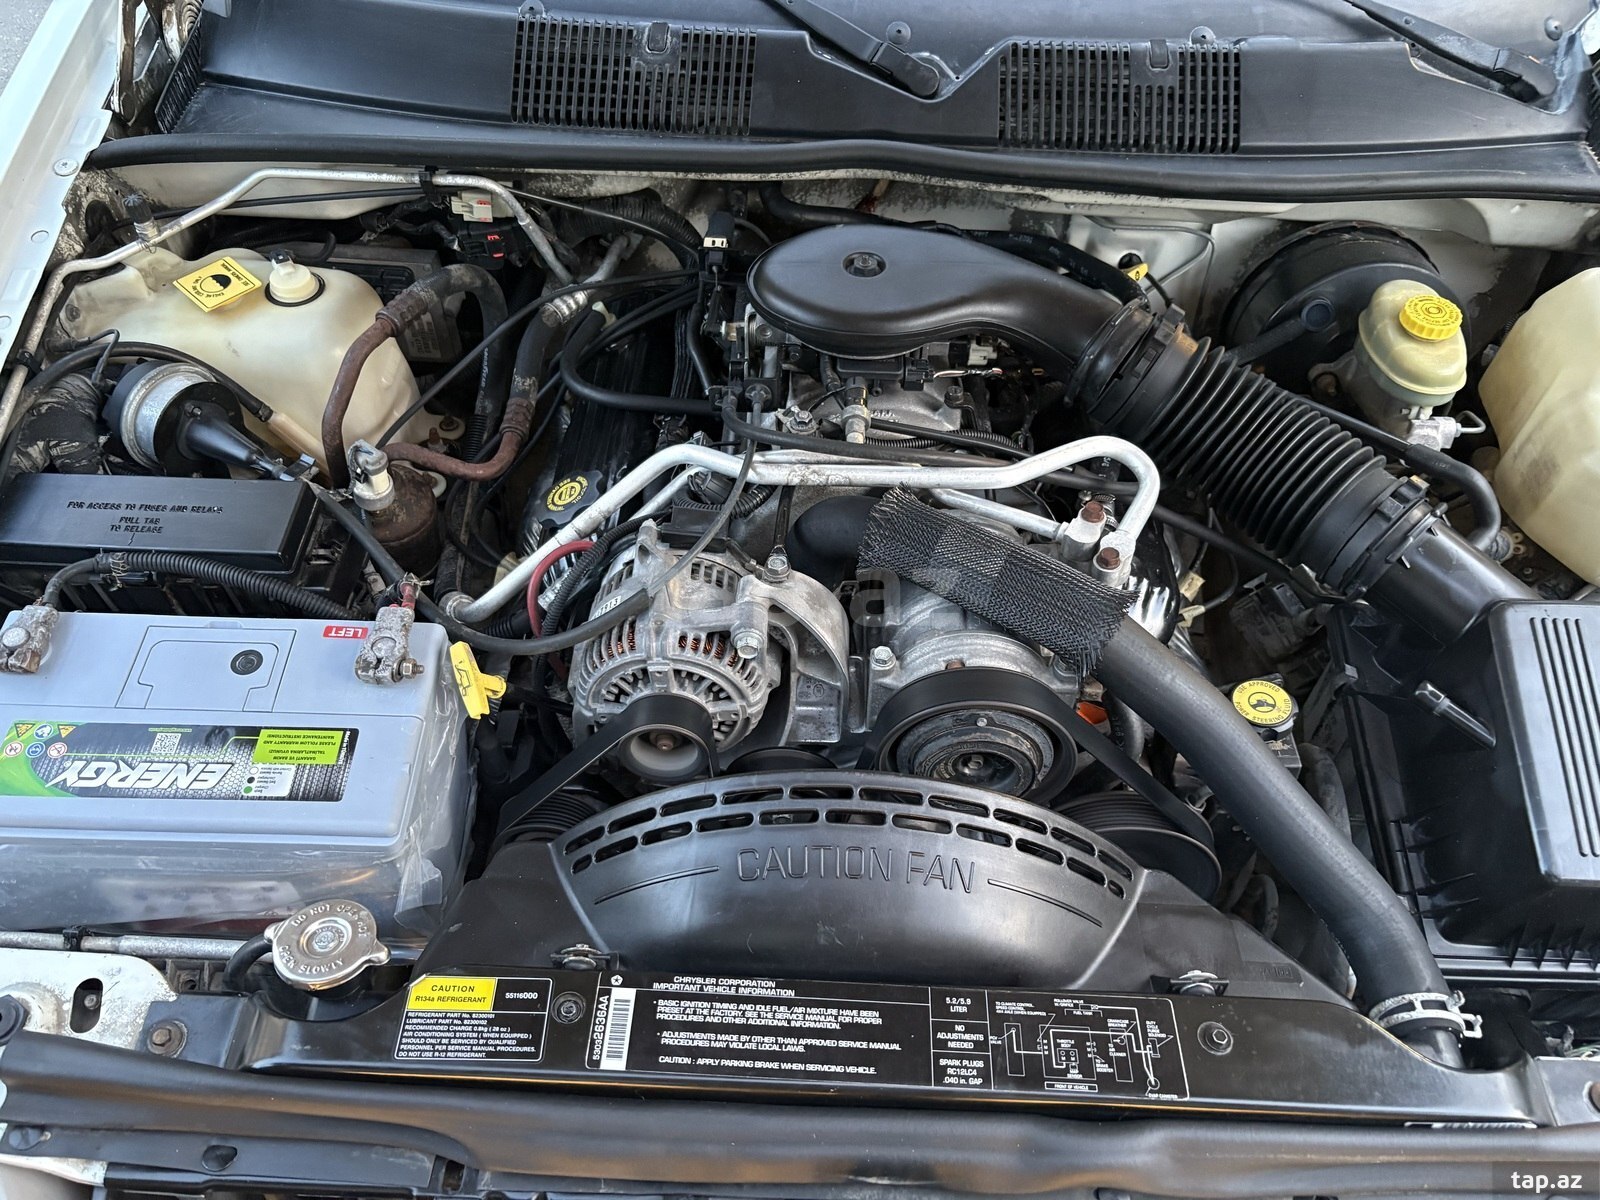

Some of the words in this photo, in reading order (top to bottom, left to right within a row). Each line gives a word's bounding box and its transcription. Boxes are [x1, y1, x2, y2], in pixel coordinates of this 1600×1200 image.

[87, 502, 122, 510] ACCESS
[126, 503, 136, 511] TO
[169, 504, 187, 512] AND
[119, 516, 140, 524] PULL
[144, 517, 161, 525] TAB
[124, 525, 163, 533] RELEASE
[328, 627, 363, 637] LEFT
[1237, 685, 1247, 694] USE
[1248, 681, 1280, 693] APPROVED
[1235, 701, 1250, 716] POWER
[1252, 715, 1284, 723] STEERING
[1282, 698, 1291, 714] FLUID
[44, 760, 234, 789] ENERGY
[737, 845, 893, 882] CAUTION
[906, 850, 975, 894] FAN
[291, 913, 307, 927] DO
[309, 904, 331, 916] NOT
[336, 904, 358, 921] OPEN
[279, 945, 294, 969] OPEN
[298, 958, 343, 974] SLOWLY
[674, 976, 716, 985] CHRYSLER
[719, 978, 775, 988] CORPORATION
[653, 982, 700, 992] IMPORTANT
[703, 985, 736, 994] VEHICLE
[738, 986, 795, 997] INFORMATION
[946, 997, 971, 1005] 5.2/5.9
[658, 1000, 679, 1008] BASIC
[680, 1001, 711, 1009] IGNITION
[712, 1002, 737, 1011] TIMING
[756, 1004, 771, 1012] IDLE
[772, 1005, 806, 1014] FUEL/AIR
[807, 1007, 838, 1015] MIXTURE
[839, 1008, 858, 1016] HAVE
[859, 1009, 879, 1017] BEEN
[656, 1014, 704, 1023] PROCEDURES
[722, 1017, 746, 1025] OTHER
[747, 1018, 789, 1027] ADDITIONAL
[657, 1007, 684, 1015] PRESET
[745, 1011, 758, 1019] SEE
[775, 1013, 804, 1021] SERVICE
[805, 1014, 837, 1022] MANUAL
[853, 1017, 882, 1025] PROPER
[592, 995, 609, 1061] 53032636AA
[662, 1031, 716, 1040] ADJUSTMENTS
[717, 1034, 738, 1042] MADE
[751, 1035, 776, 1044] OTHER
[777, 1037, 798, 1045] THAN
[798, 1038, 837, 1047] APPROVED
[838, 1040, 868, 1048] SERVICE
[869, 1041, 902, 1050] MANUAL
[937, 1032, 984, 1041] ADJUSTMENTS
[661, 1038, 710, 1047] PROCEDURES
[711, 1040, 727, 1048] MAY
[728, 1041, 757, 1049] VIOLATE
[758, 1043, 781, 1051] LOCAL
[782, 1044, 806, 1052] LAWS.
[948, 1041, 974, 1049] NEEDED
[659, 1056, 691, 1065] CAUTION
[696, 1058, 719, 1066] APPLY
[720, 1059, 753, 1068] PARKING
[755, 1061, 780, 1069] BRAKE
[781, 1062, 805, 1070] WHEN
[806, 1063, 844, 1072] SERVICING
[845, 1065, 877, 1074] VEHICLE.
[940, 1059, 961, 1067] SPARK
